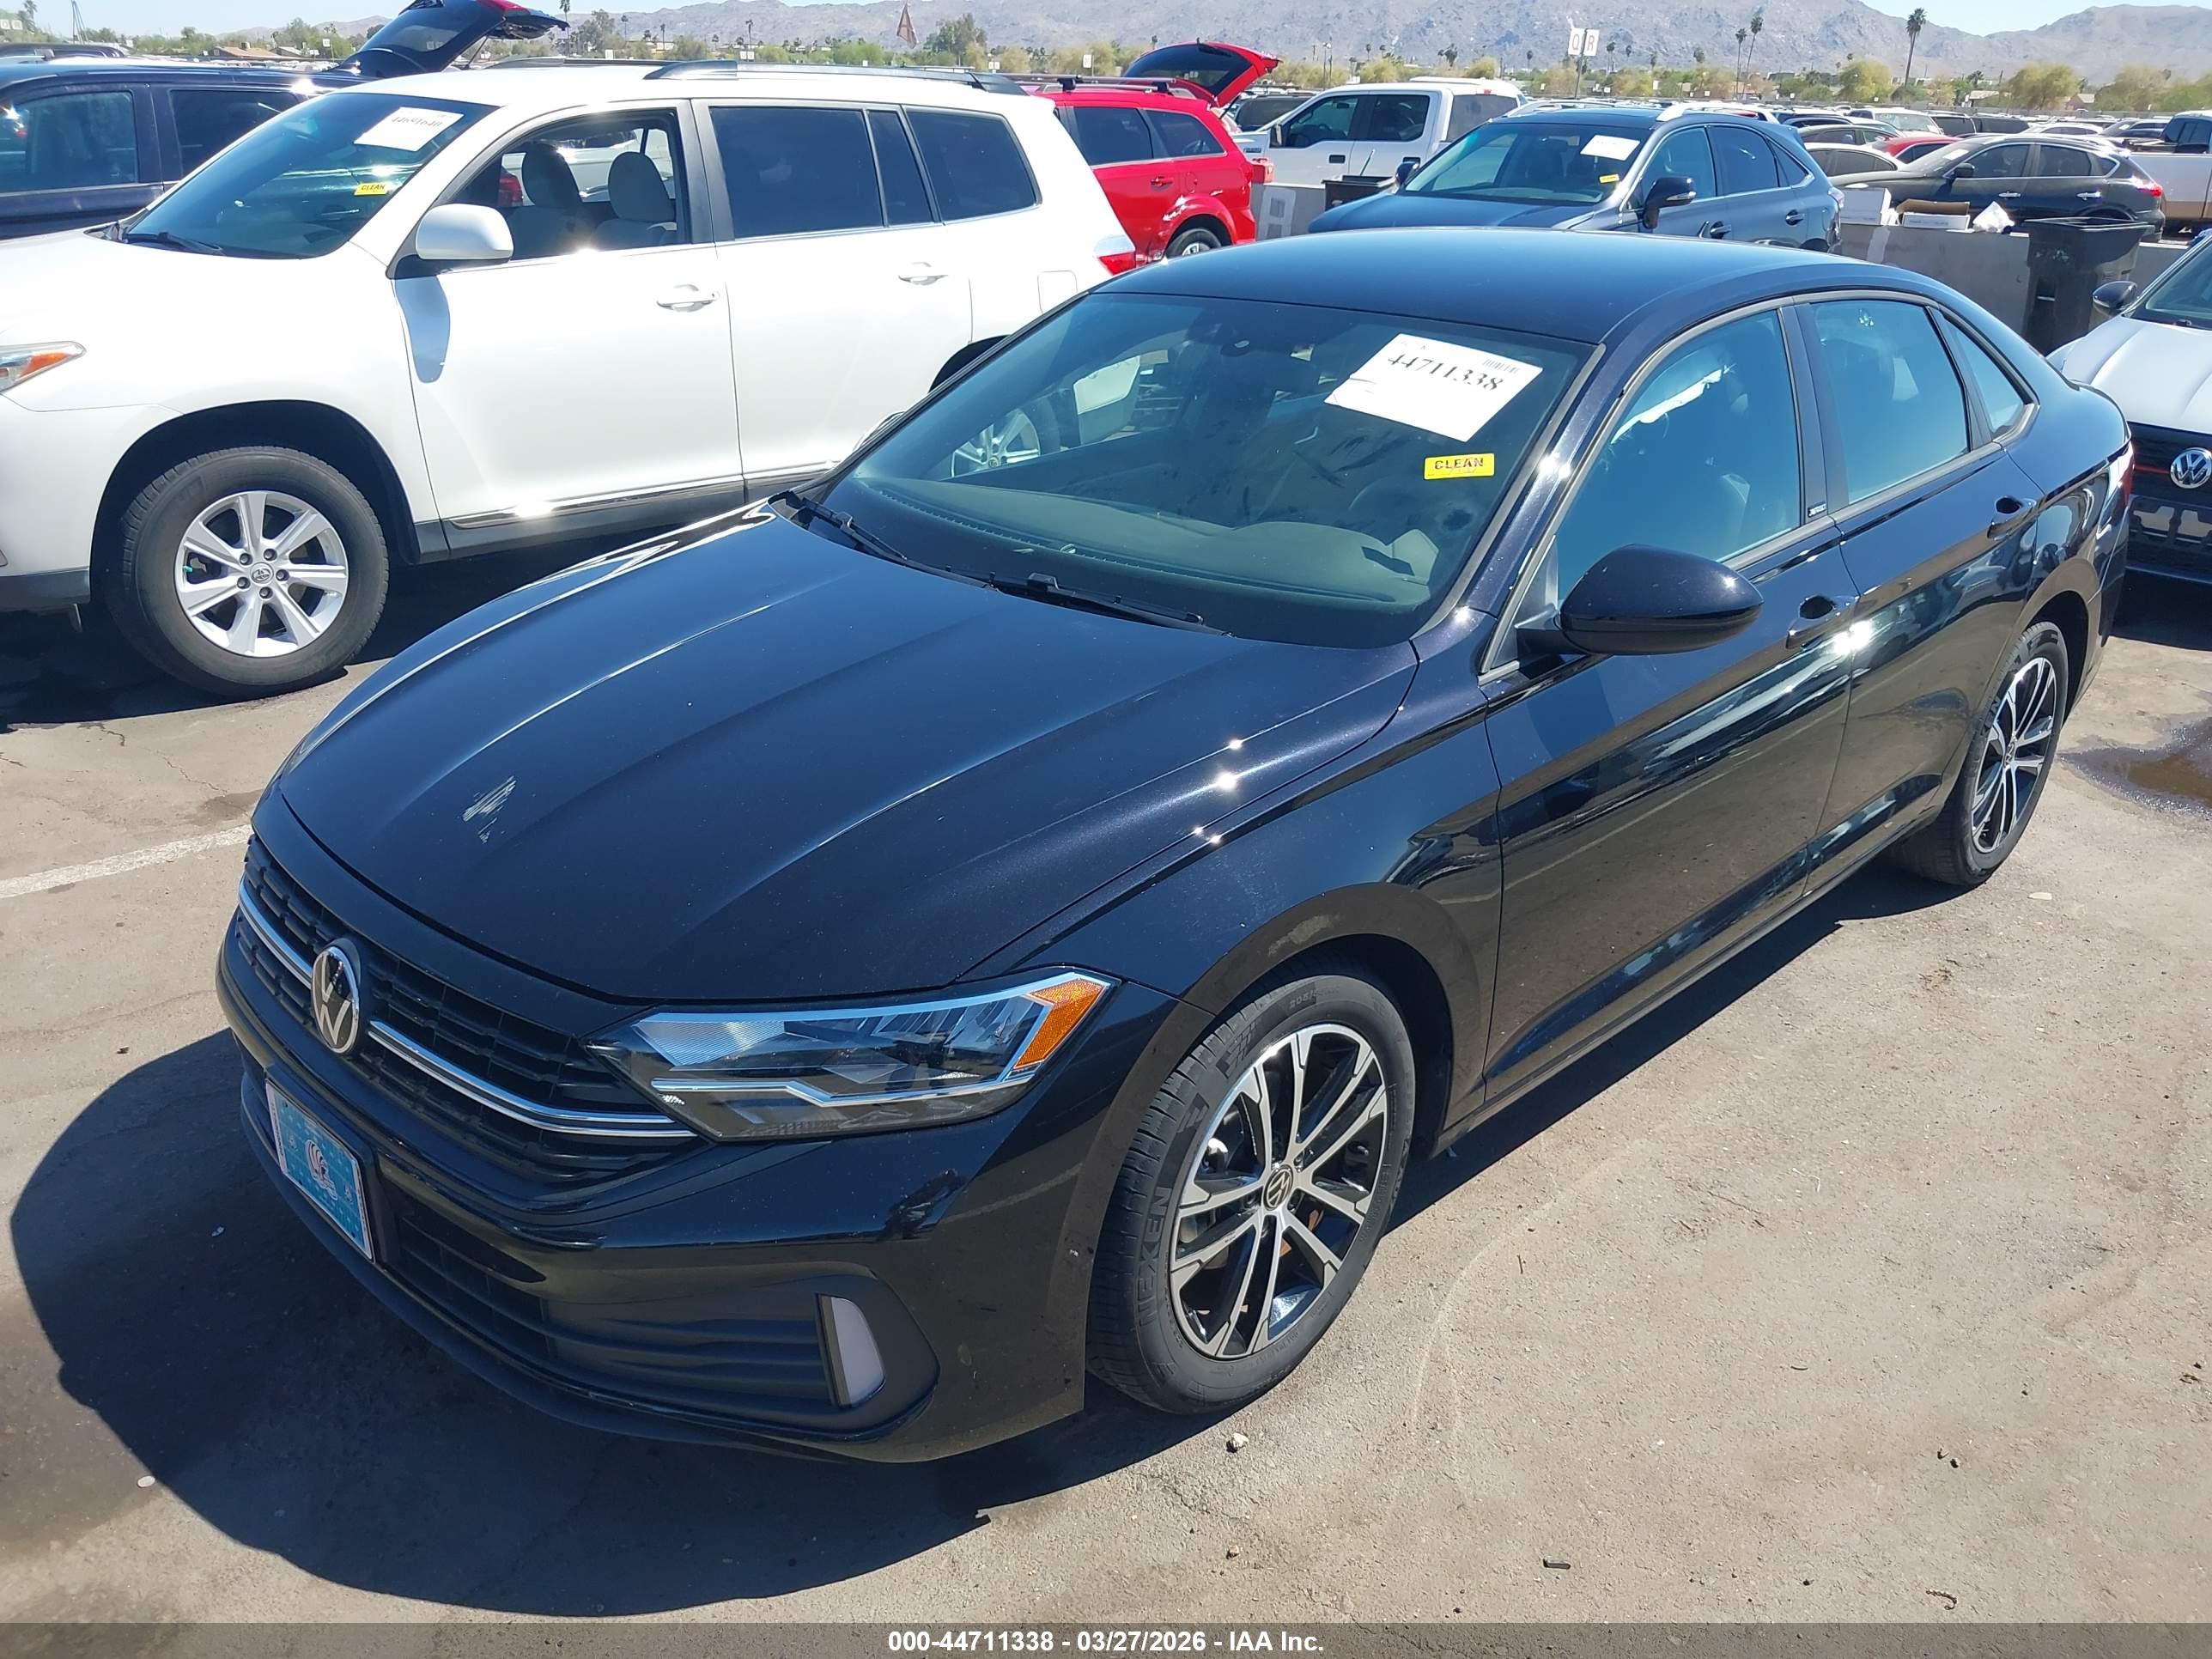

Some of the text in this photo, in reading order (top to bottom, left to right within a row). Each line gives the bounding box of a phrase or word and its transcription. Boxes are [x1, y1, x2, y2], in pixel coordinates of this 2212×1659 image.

[1587, 35, 1595, 52] R
[1387, 353, 1504, 392] 44711338
[1435, 458, 1484, 470] CLEAN
[1136, 1186, 1174, 1328] NEXEN
